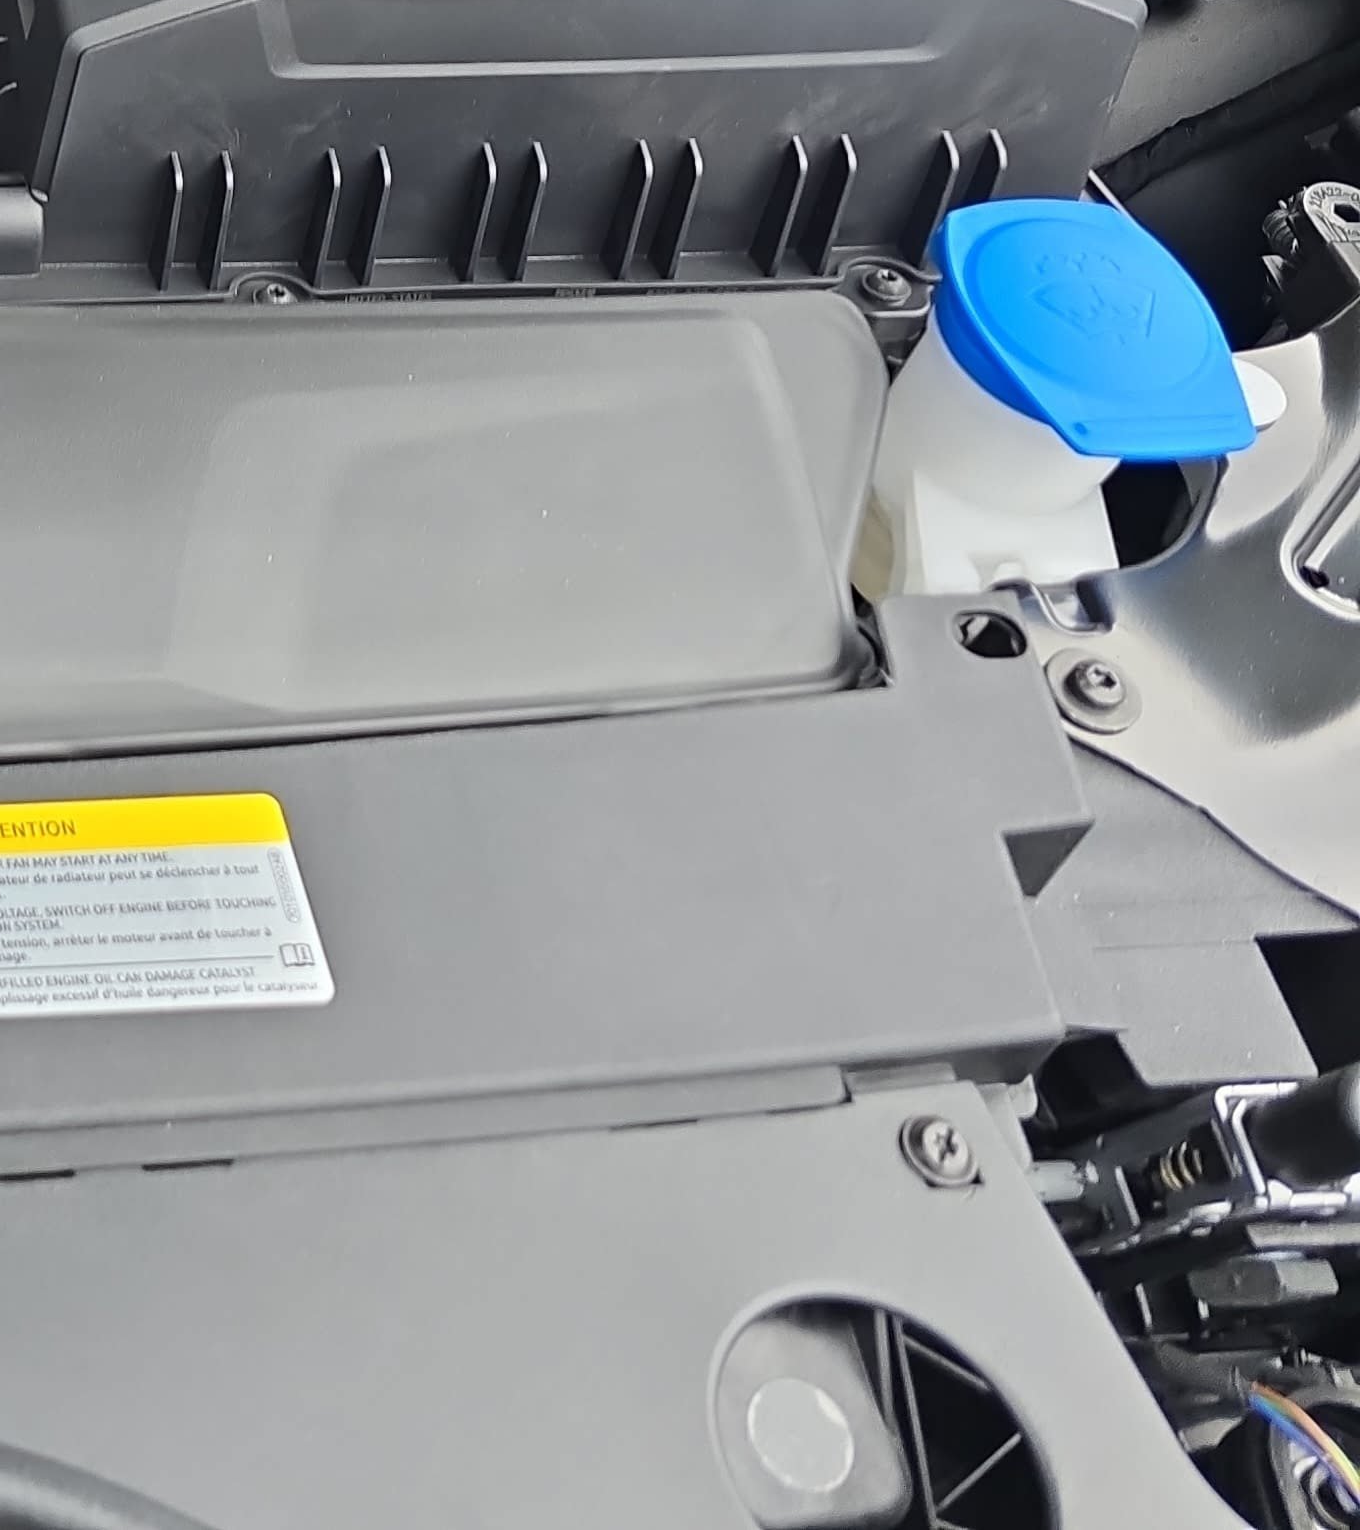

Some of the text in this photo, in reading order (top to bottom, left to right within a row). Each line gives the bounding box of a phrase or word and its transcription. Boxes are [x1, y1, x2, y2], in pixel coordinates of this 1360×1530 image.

[6, 857, 30, 870] FAN
[33, 856, 58, 868] MAY
[60, 855, 97, 867] START
[99, 854, 114, 866] AT
[115, 852, 140, 864] ANY
[33, 872, 48, 884] de
[51, 871, 106, 883] radiateur
[108, 870, 137, 883] peut
[140, 869, 153, 879] se
[157, 865, 221, 878] déclencher
[235, 864, 259, 874] tout
[44, 904, 91, 917] SWITCH
[93, 903, 116, 915] OFF
[119, 900, 162, 913] ENGINE
[167, 898, 211, 911] BEFORE
[215, 896, 277, 910] TOUCHING
[97, 933, 109, 943] le
[112, 931, 156, 943] moteur
[160, 930, 195, 941] avant
[197, 928, 211, 939] de
[214, 927, 262, 939] toucher
[46, 974, 91, 987] ENGINE
[94, 973, 114, 984] OIL
[117, 972, 142, 983] CAN
[145, 969, 196, 982] DAMAGE
[214, 984, 240, 996] pour
